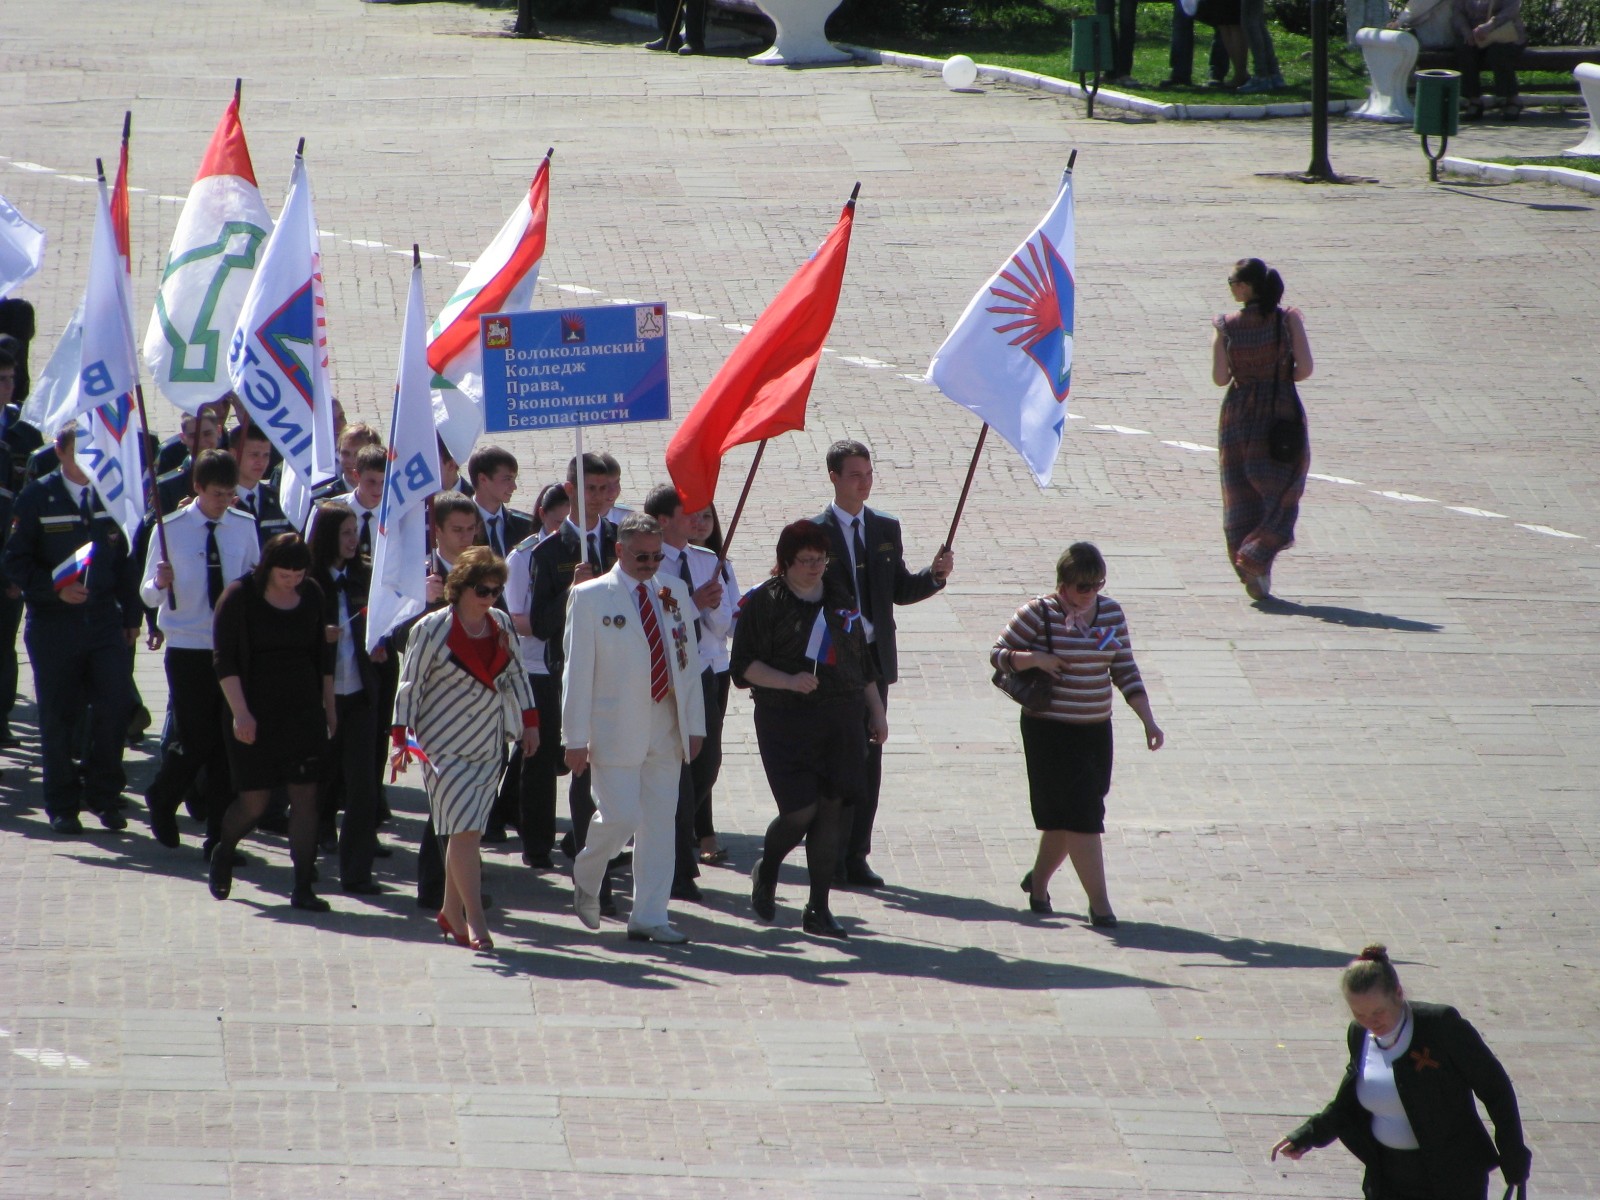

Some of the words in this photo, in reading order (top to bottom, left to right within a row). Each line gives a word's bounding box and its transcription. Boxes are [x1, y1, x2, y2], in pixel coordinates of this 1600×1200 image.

[505, 340, 646, 362] Волоколамский
[505, 361, 586, 378] Колледж
[506, 380, 565, 396] Права,
[507, 394, 607, 411] Экономики
[614, 392, 624, 403] и
[508, 408, 630, 427] Безопасности
